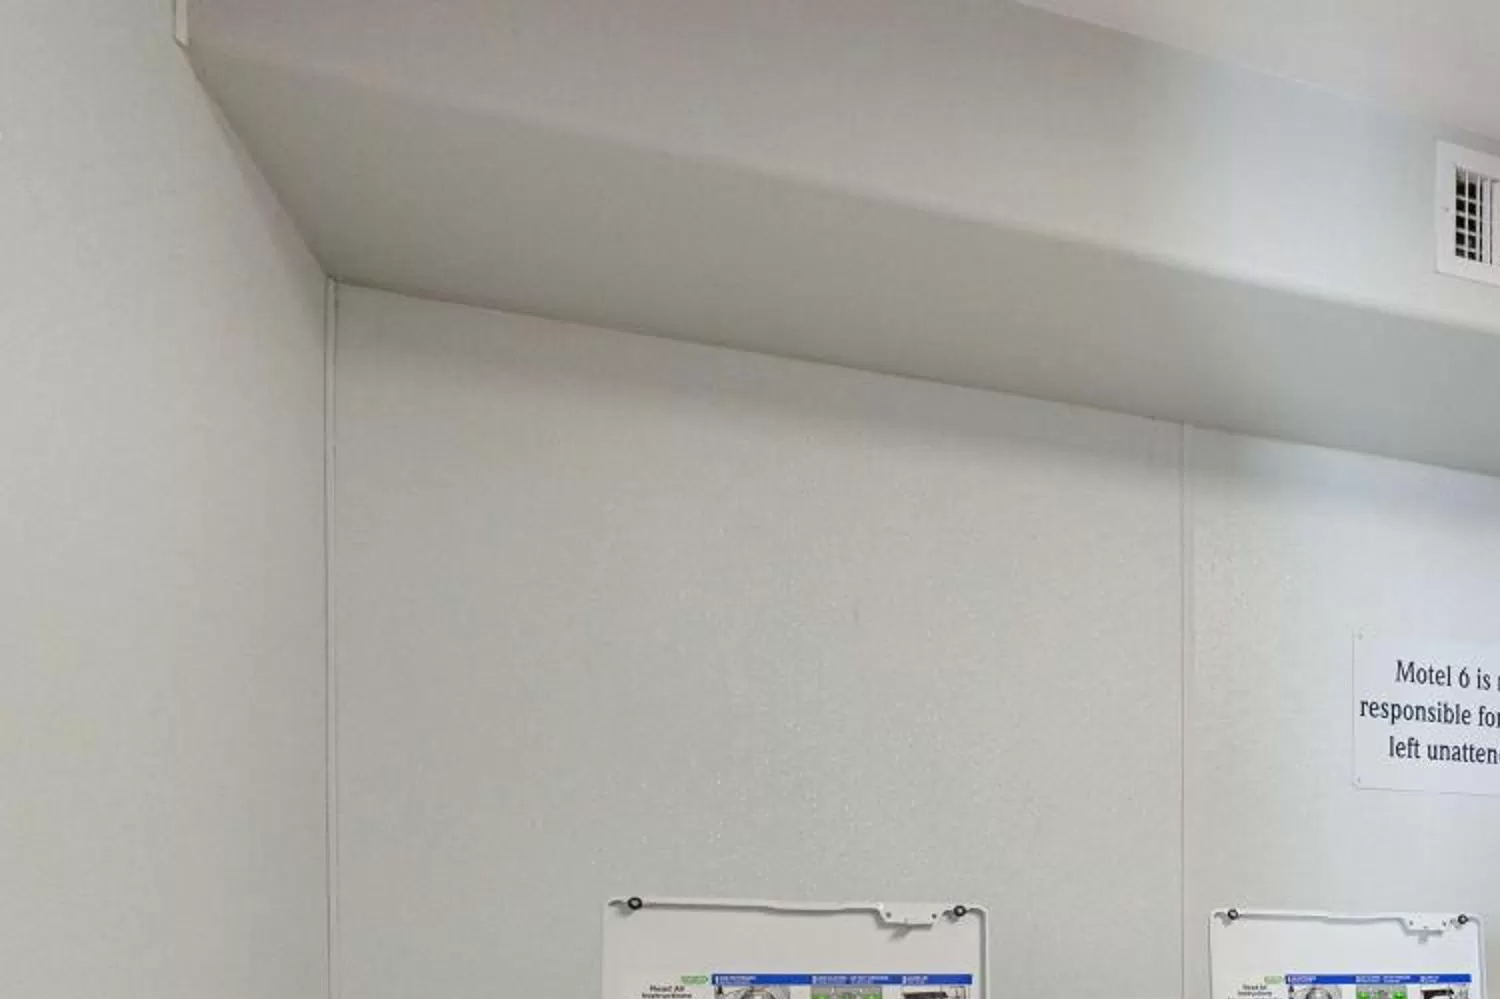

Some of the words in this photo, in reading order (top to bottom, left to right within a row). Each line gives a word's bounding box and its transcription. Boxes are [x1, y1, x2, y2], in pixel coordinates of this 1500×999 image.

[1395, 659, 1452, 687] Motel
[1459, 666, 1471, 689] 6
[1477, 668, 1491, 691] is
[1359, 699, 1471, 725] responsible
[1389, 735, 1421, 759] left
